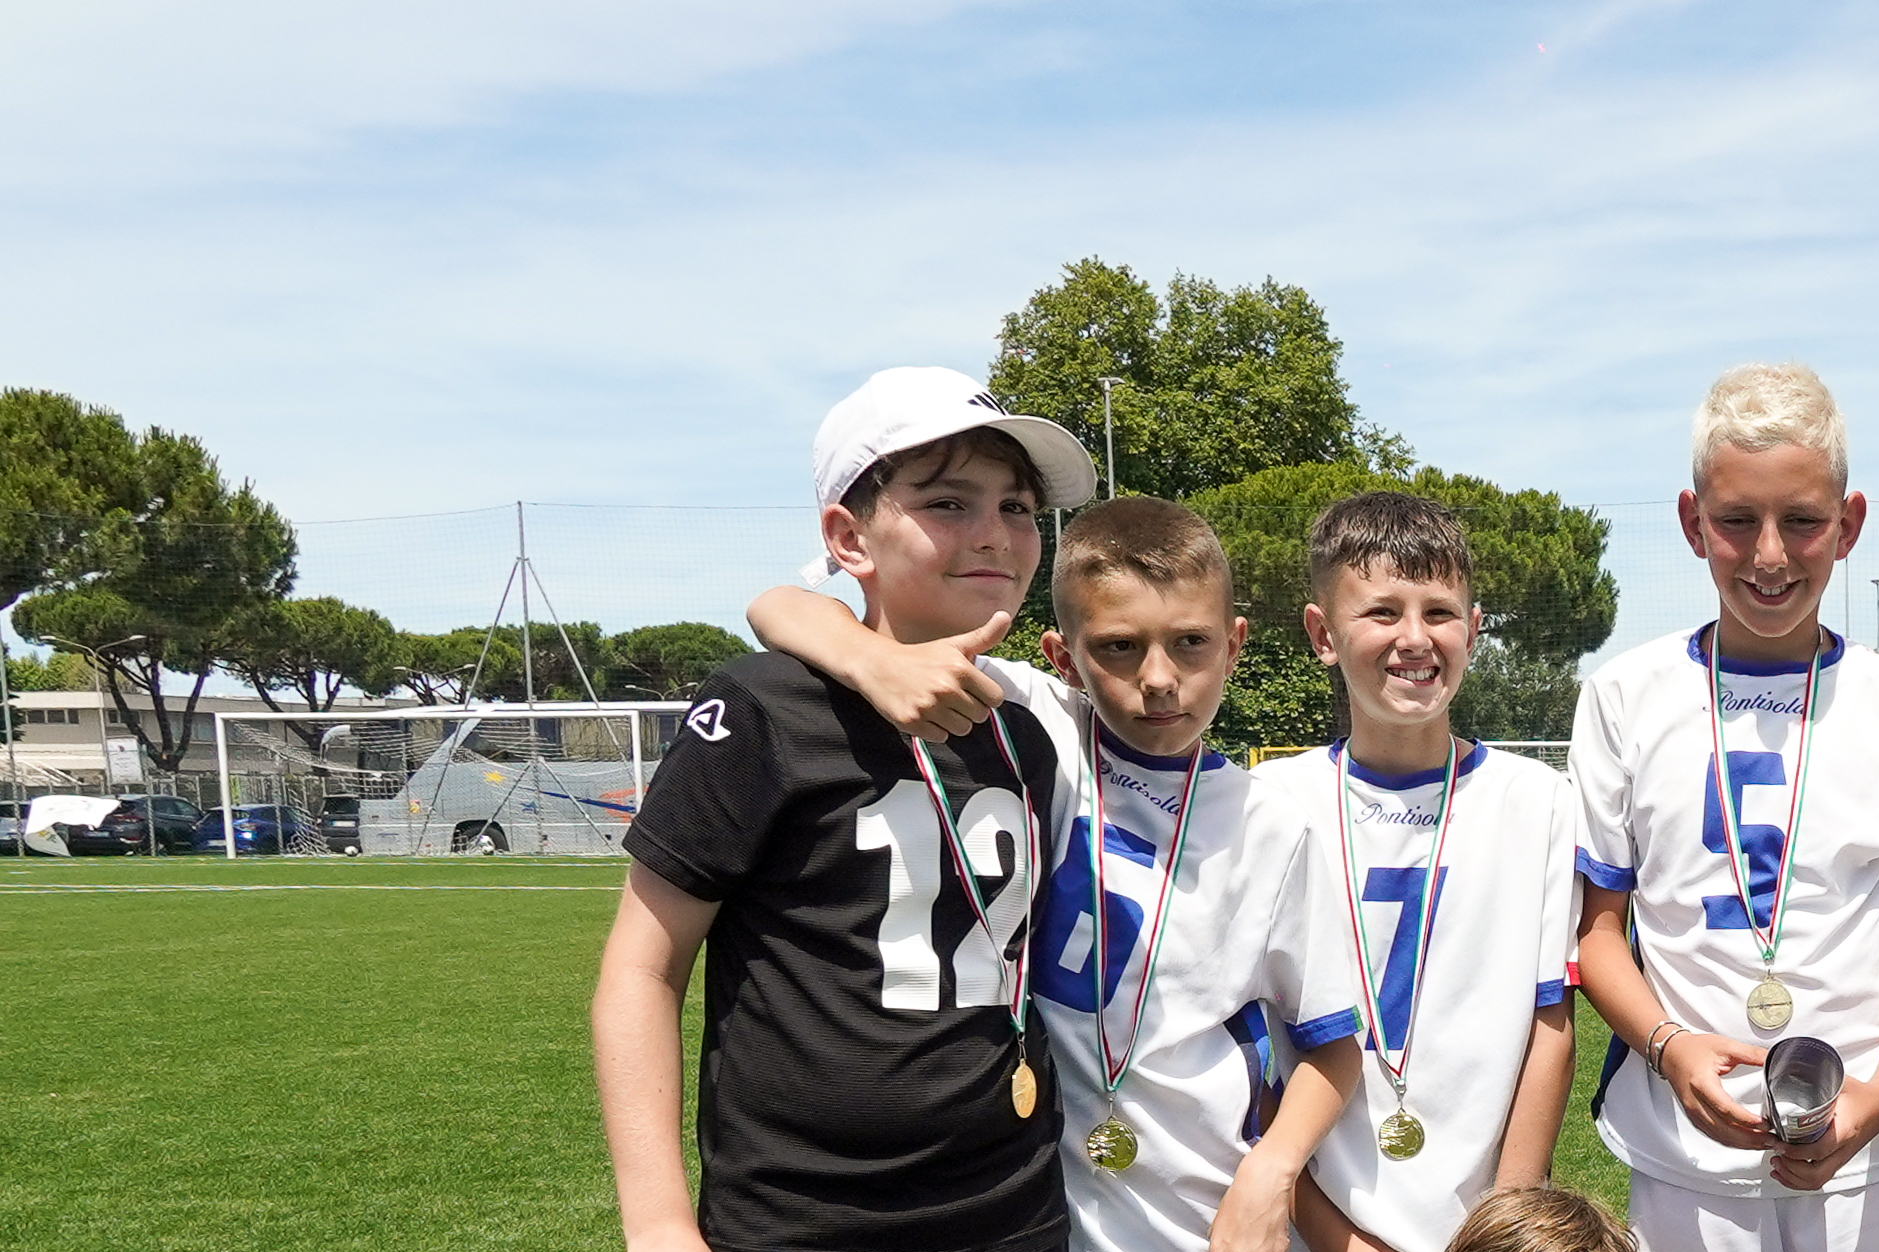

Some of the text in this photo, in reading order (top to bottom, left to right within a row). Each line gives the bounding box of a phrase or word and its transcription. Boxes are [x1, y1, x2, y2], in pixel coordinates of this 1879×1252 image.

[855, 779, 1040, 1011] 12
[1031, 815, 1157, 1013] 6
[1700, 751, 1787, 930] 5
[1361, 866, 1449, 1050] 7
